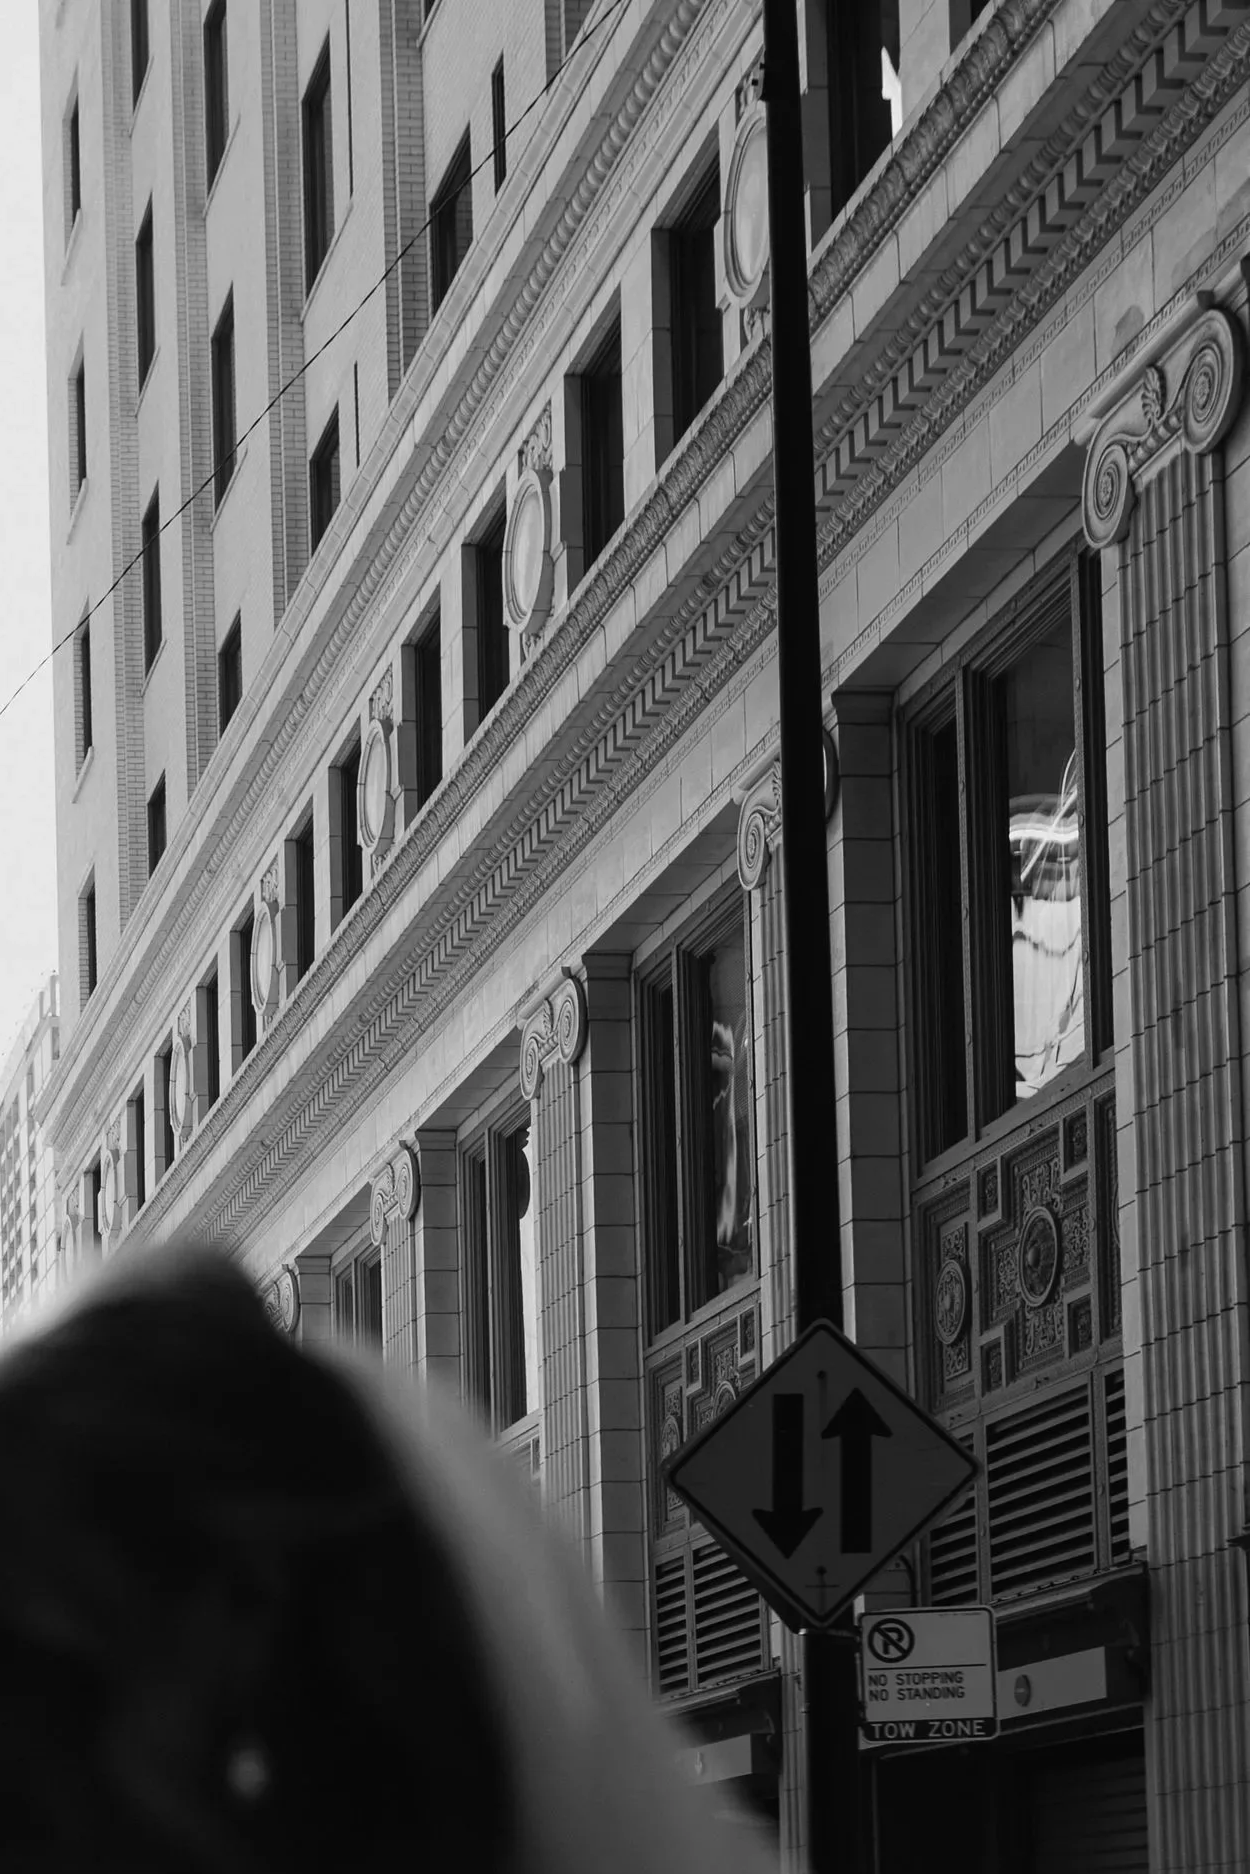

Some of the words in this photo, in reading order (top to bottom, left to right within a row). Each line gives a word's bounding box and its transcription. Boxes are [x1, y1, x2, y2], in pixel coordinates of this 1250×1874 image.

[868, 1674, 888, 1687] NO
[896, 1671, 964, 1686] STOPPING
[869, 1689, 889, 1701] NO
[897, 1686, 965, 1701] STANDING
[870, 1722, 916, 1739] TOW
[928, 1720, 986, 1737] ZONE
